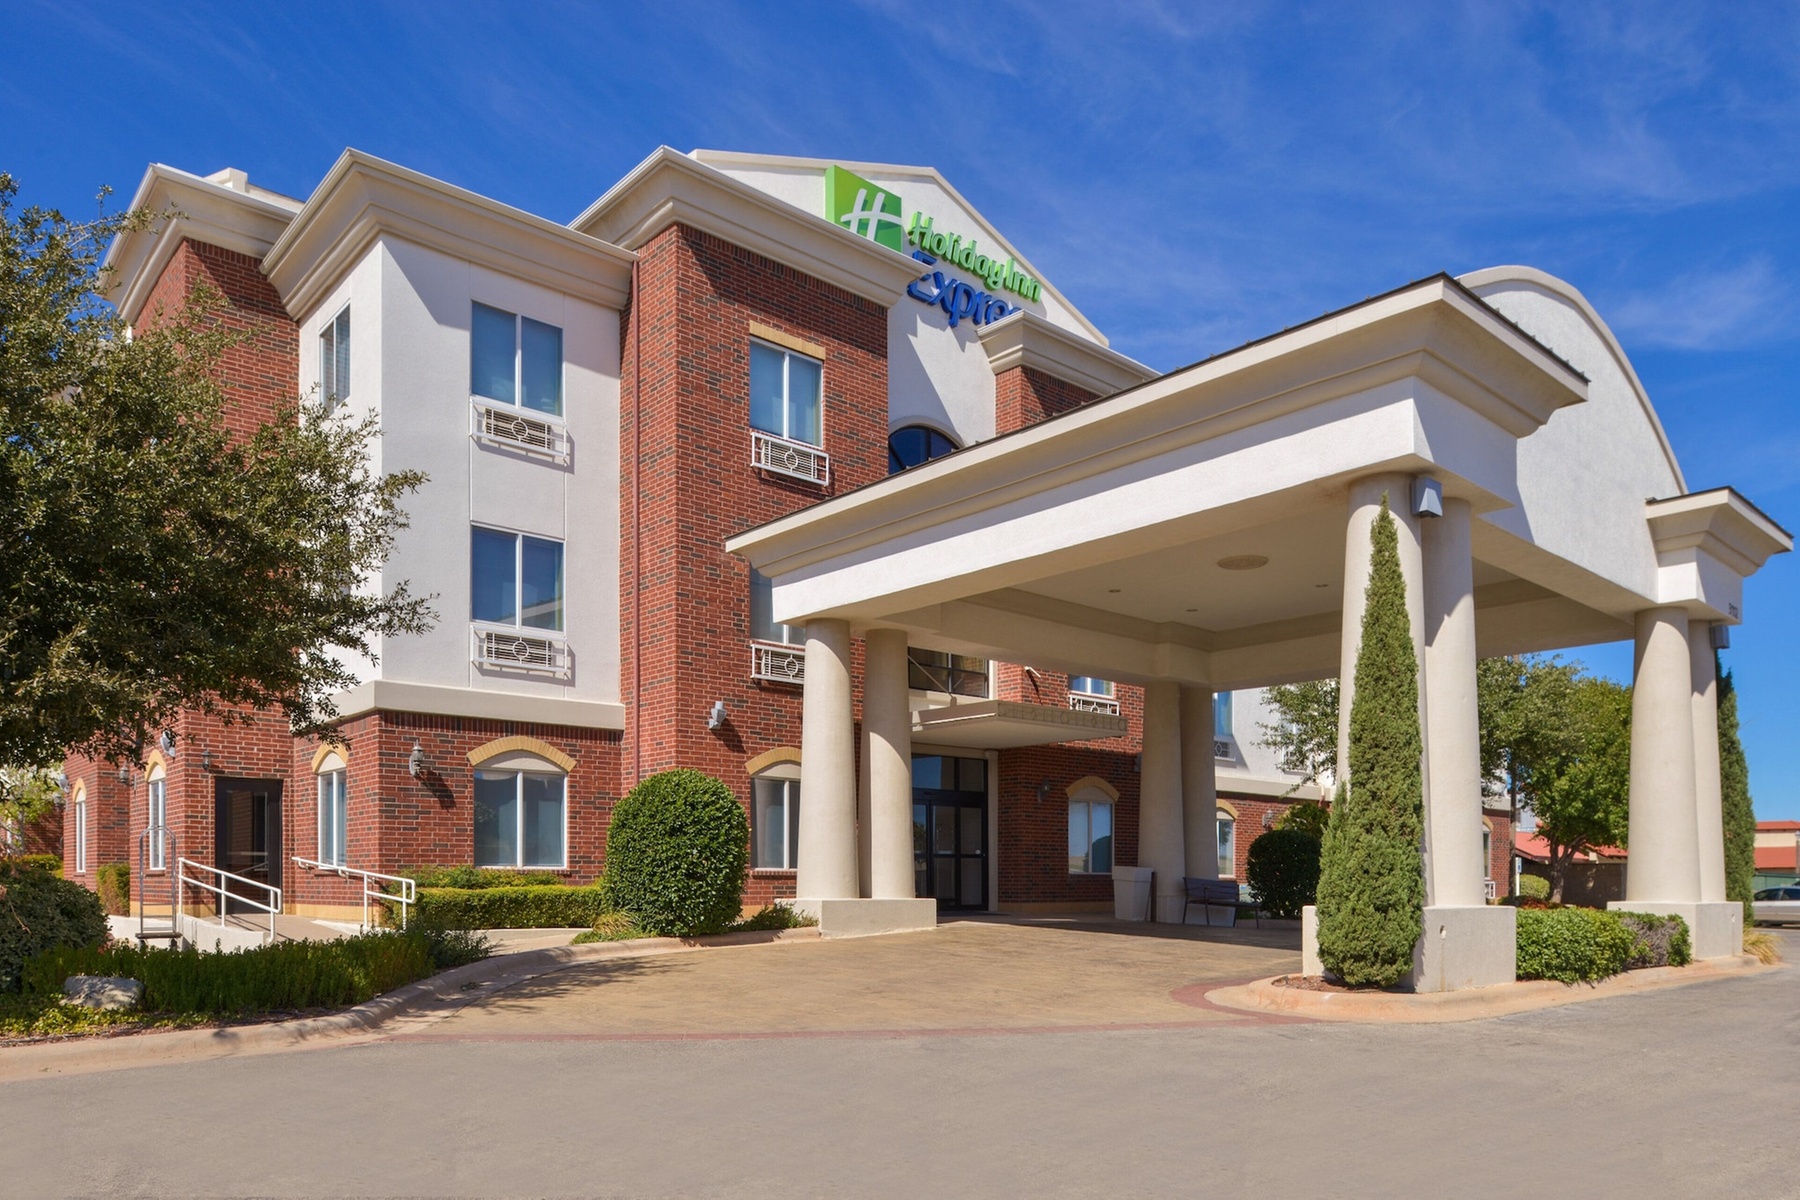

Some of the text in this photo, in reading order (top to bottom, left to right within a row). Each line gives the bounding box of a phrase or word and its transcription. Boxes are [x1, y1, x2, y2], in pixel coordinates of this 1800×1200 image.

[907, 250, 1023, 328] Expre
[908, 211, 1042, 303] Holiday Inn
